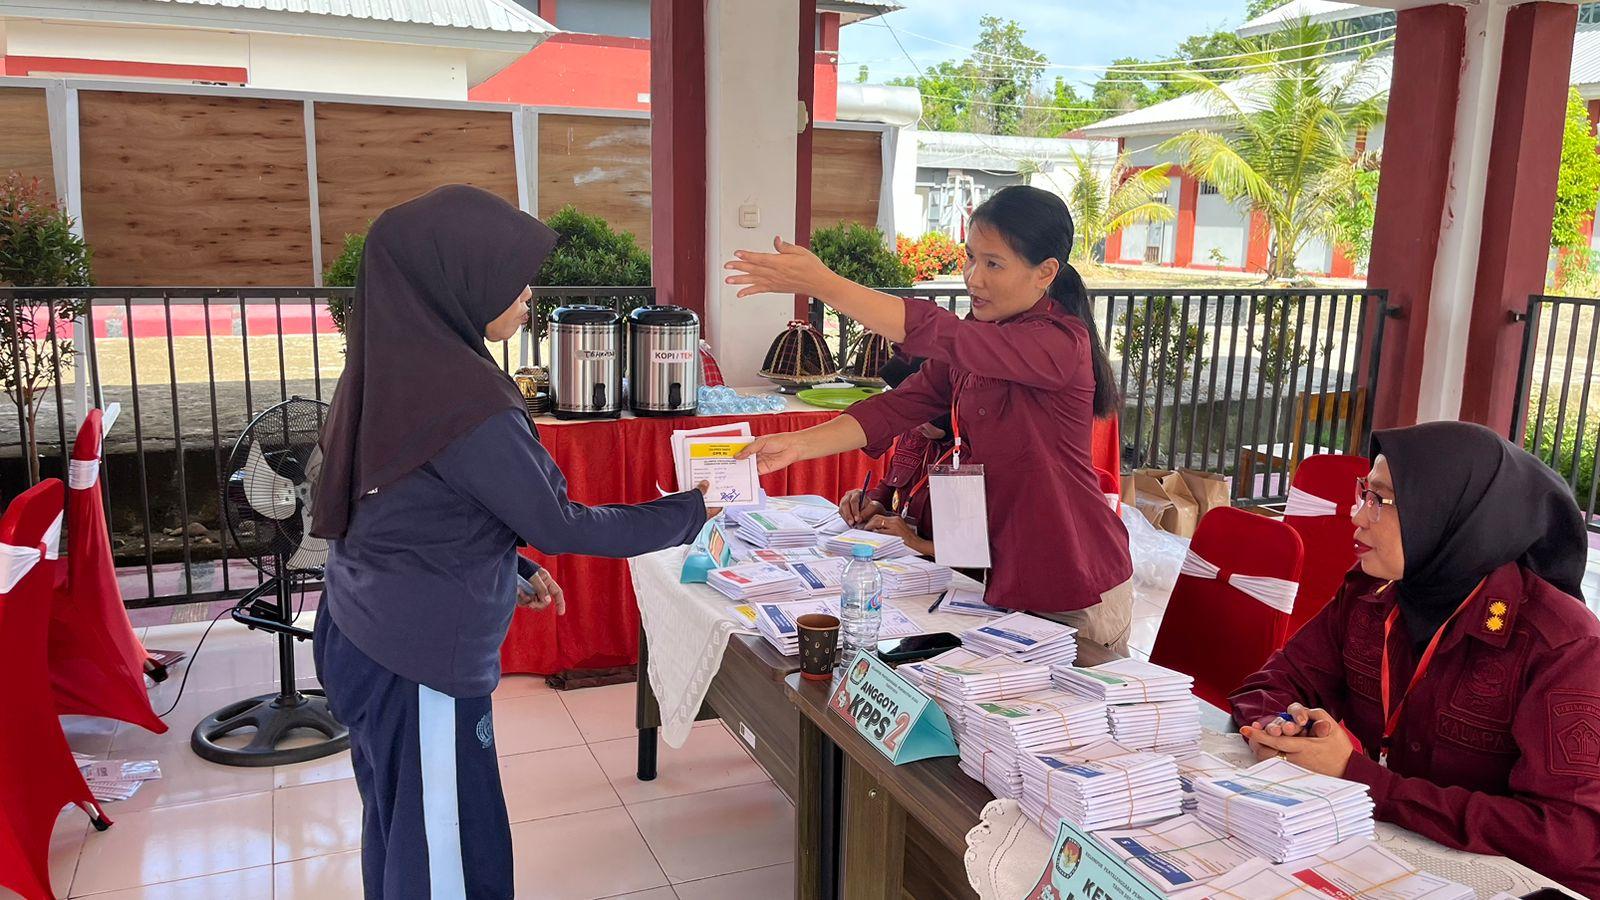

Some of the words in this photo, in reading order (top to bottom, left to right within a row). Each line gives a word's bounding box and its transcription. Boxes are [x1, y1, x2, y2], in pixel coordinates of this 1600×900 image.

[655, 352, 675, 360] KOPI
[680, 352, 693, 360] TEH
[861, 681, 900, 717] ANGGOTA
[847, 693, 891, 740] KPPS
[882, 711, 911, 753] 2
